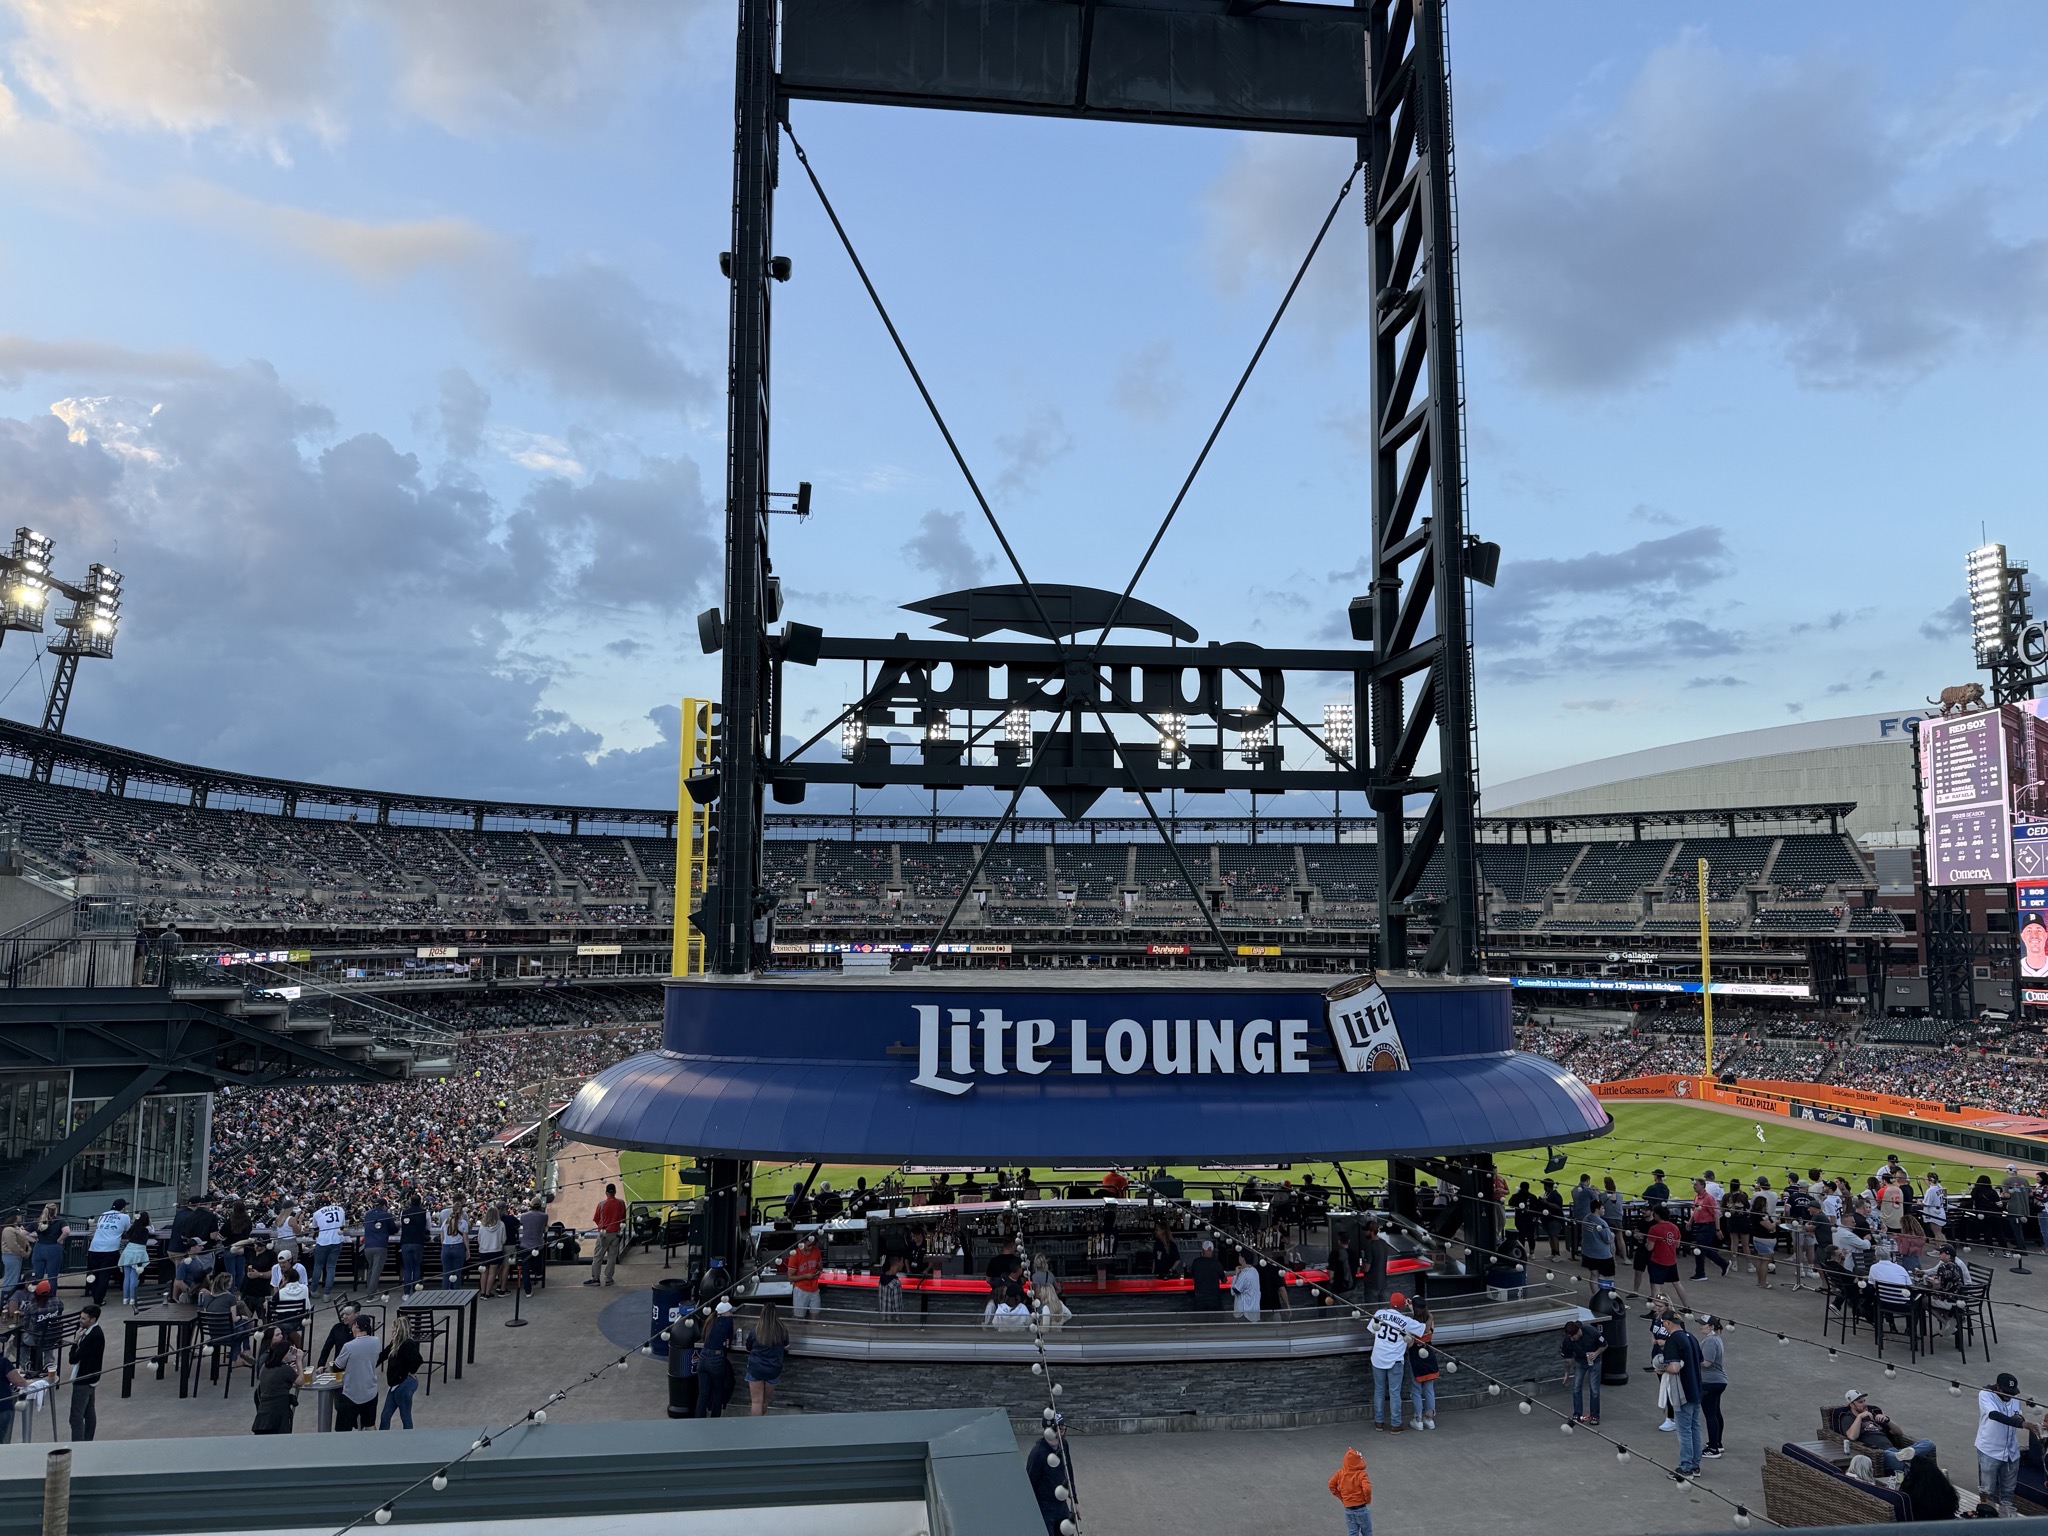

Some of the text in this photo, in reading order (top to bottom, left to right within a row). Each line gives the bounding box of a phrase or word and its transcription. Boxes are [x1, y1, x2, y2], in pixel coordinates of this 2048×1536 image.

[1949, 724, 1966, 734] RED
[1966, 718, 1986, 730] SOX
[429, 948, 447, 956] ROSE
[1152, 945, 1184, 954] Dunham's
[1622, 952, 1659, 960] Gallagher
[1653, 983, 1684, 991] Michigan.
[1339, 1000, 1390, 1048] Lite
[910, 1004, 1310, 1096] Lite LOUNGE
[1598, 1086, 1618, 1095] Little
[1856, 1092, 1878, 1102] DELIVERY
[1736, 1096, 1776, 1111] PIZZA! PIZZA!
[1916, 1102, 1940, 1112] DELIVERY
[325, 1212, 340, 1223] 31
[1666, 1232, 1674, 1245] 6
[1378, 1323, 1398, 1343] 35
